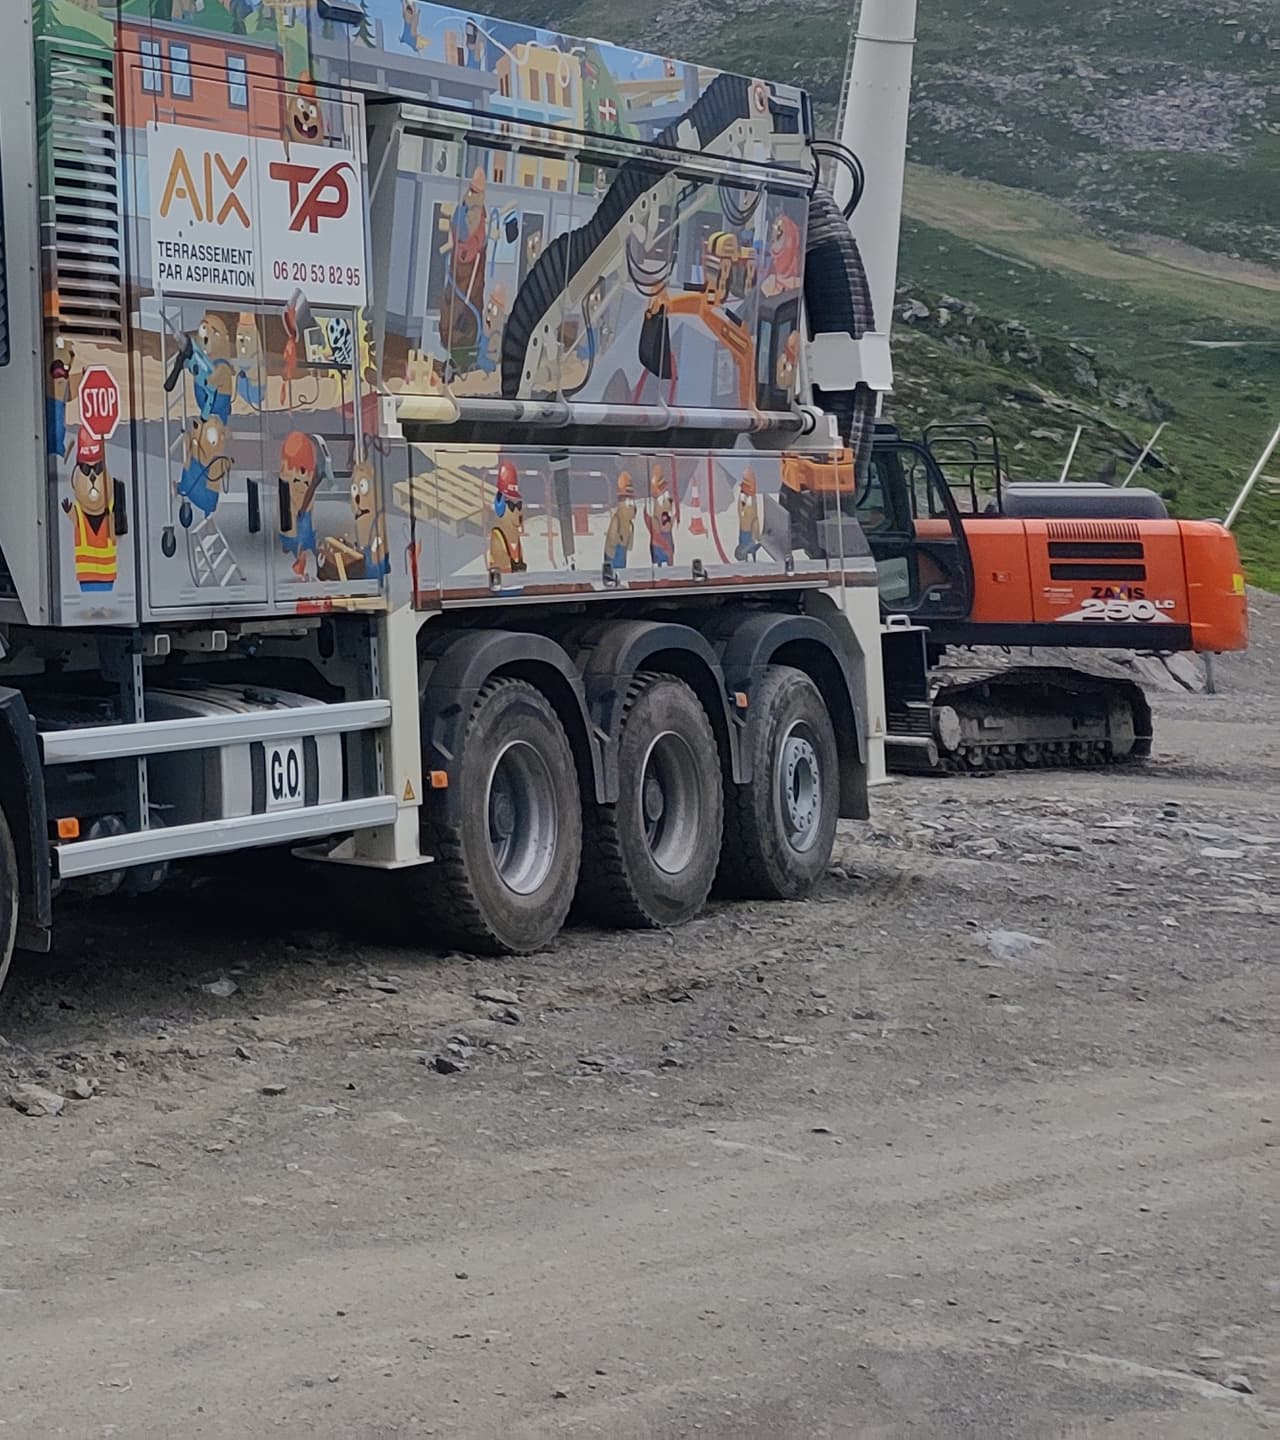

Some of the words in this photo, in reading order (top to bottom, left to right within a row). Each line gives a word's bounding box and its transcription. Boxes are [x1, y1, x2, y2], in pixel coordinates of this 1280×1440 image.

[159, 148, 251, 229] AIX
[269, 161, 359, 234] TP
[157, 241, 253, 266] TERRASSEMENT
[158, 263, 183, 280] PAR
[186, 265, 255, 288] ASPIRATION
[273, 260, 289, 281] 06
[292, 262, 308, 282] 20
[311, 264, 326, 284] 53
[329, 265, 344, 285] 82
[346, 267, 361, 287] 95
[83, 387, 116, 418] STOP
[1090, 585, 1145, 600] ZAXIS
[1081, 598, 1156, 621] 250
[1155, 600, 1176, 609] LC
